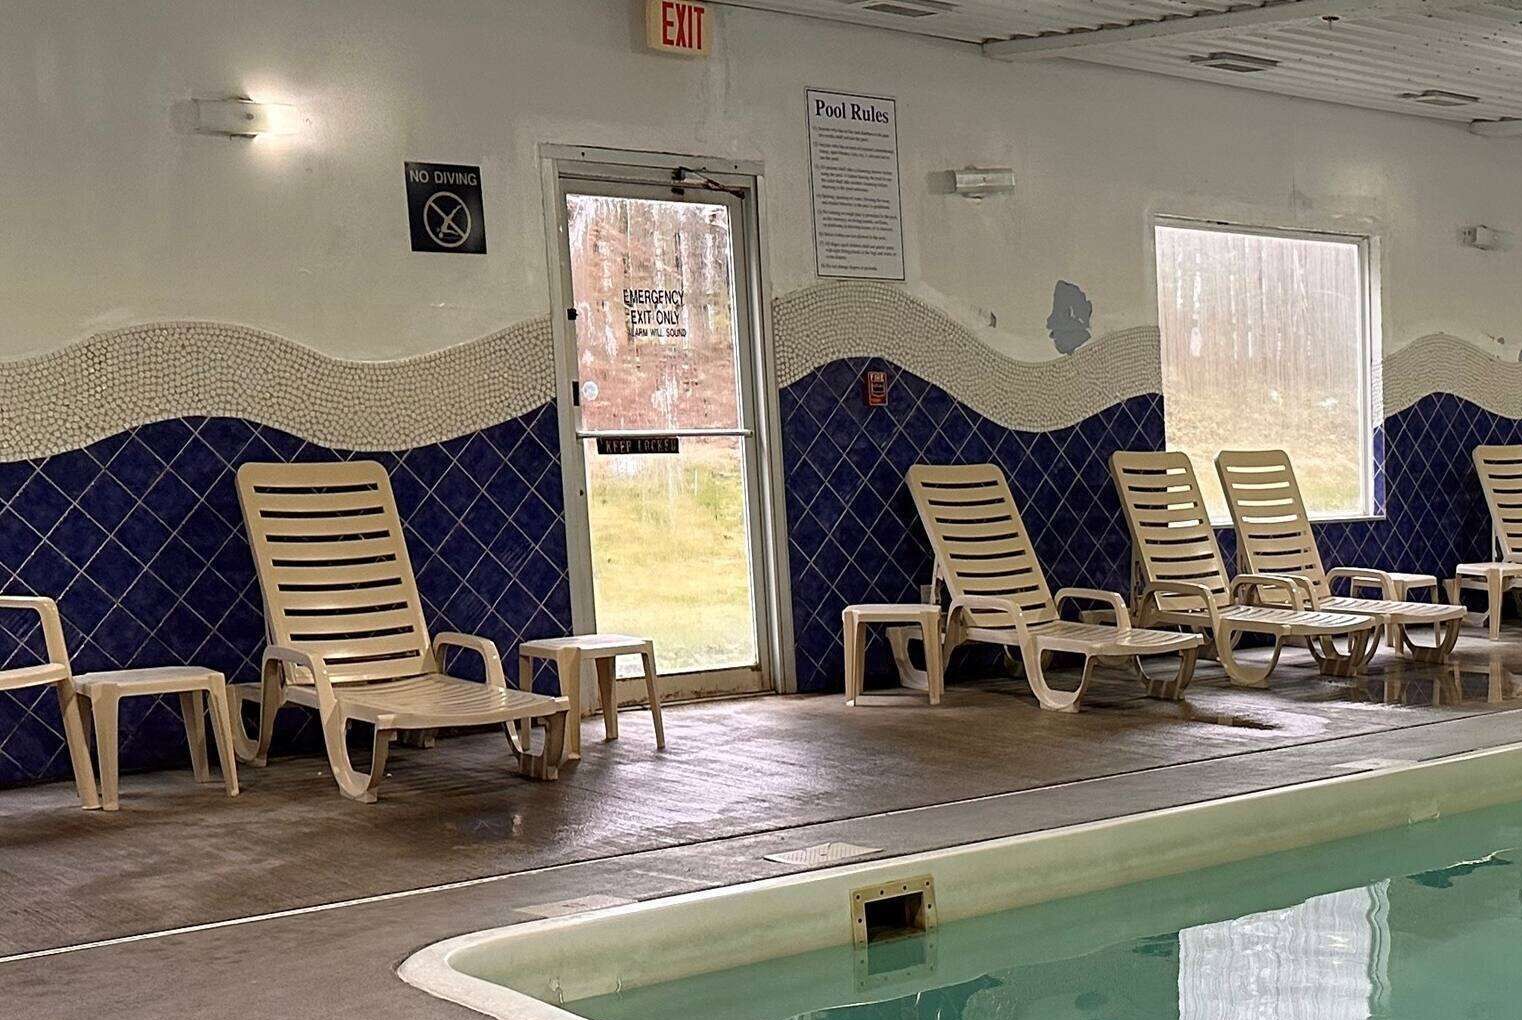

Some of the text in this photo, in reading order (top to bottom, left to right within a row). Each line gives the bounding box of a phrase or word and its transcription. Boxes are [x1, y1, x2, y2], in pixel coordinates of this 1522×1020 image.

[662, 1, 705, 50] EXIT
[815, 99, 889, 124] Pool Rules
[410, 169, 477, 186] NO DIVING
[623, 289, 684, 305] EMERGENCY
[631, 310, 680, 325] EXIT ONLY
[651, 328, 664, 337] WILL
[666, 328, 687, 337] SOUND
[605, 440, 632, 453] KEEP
